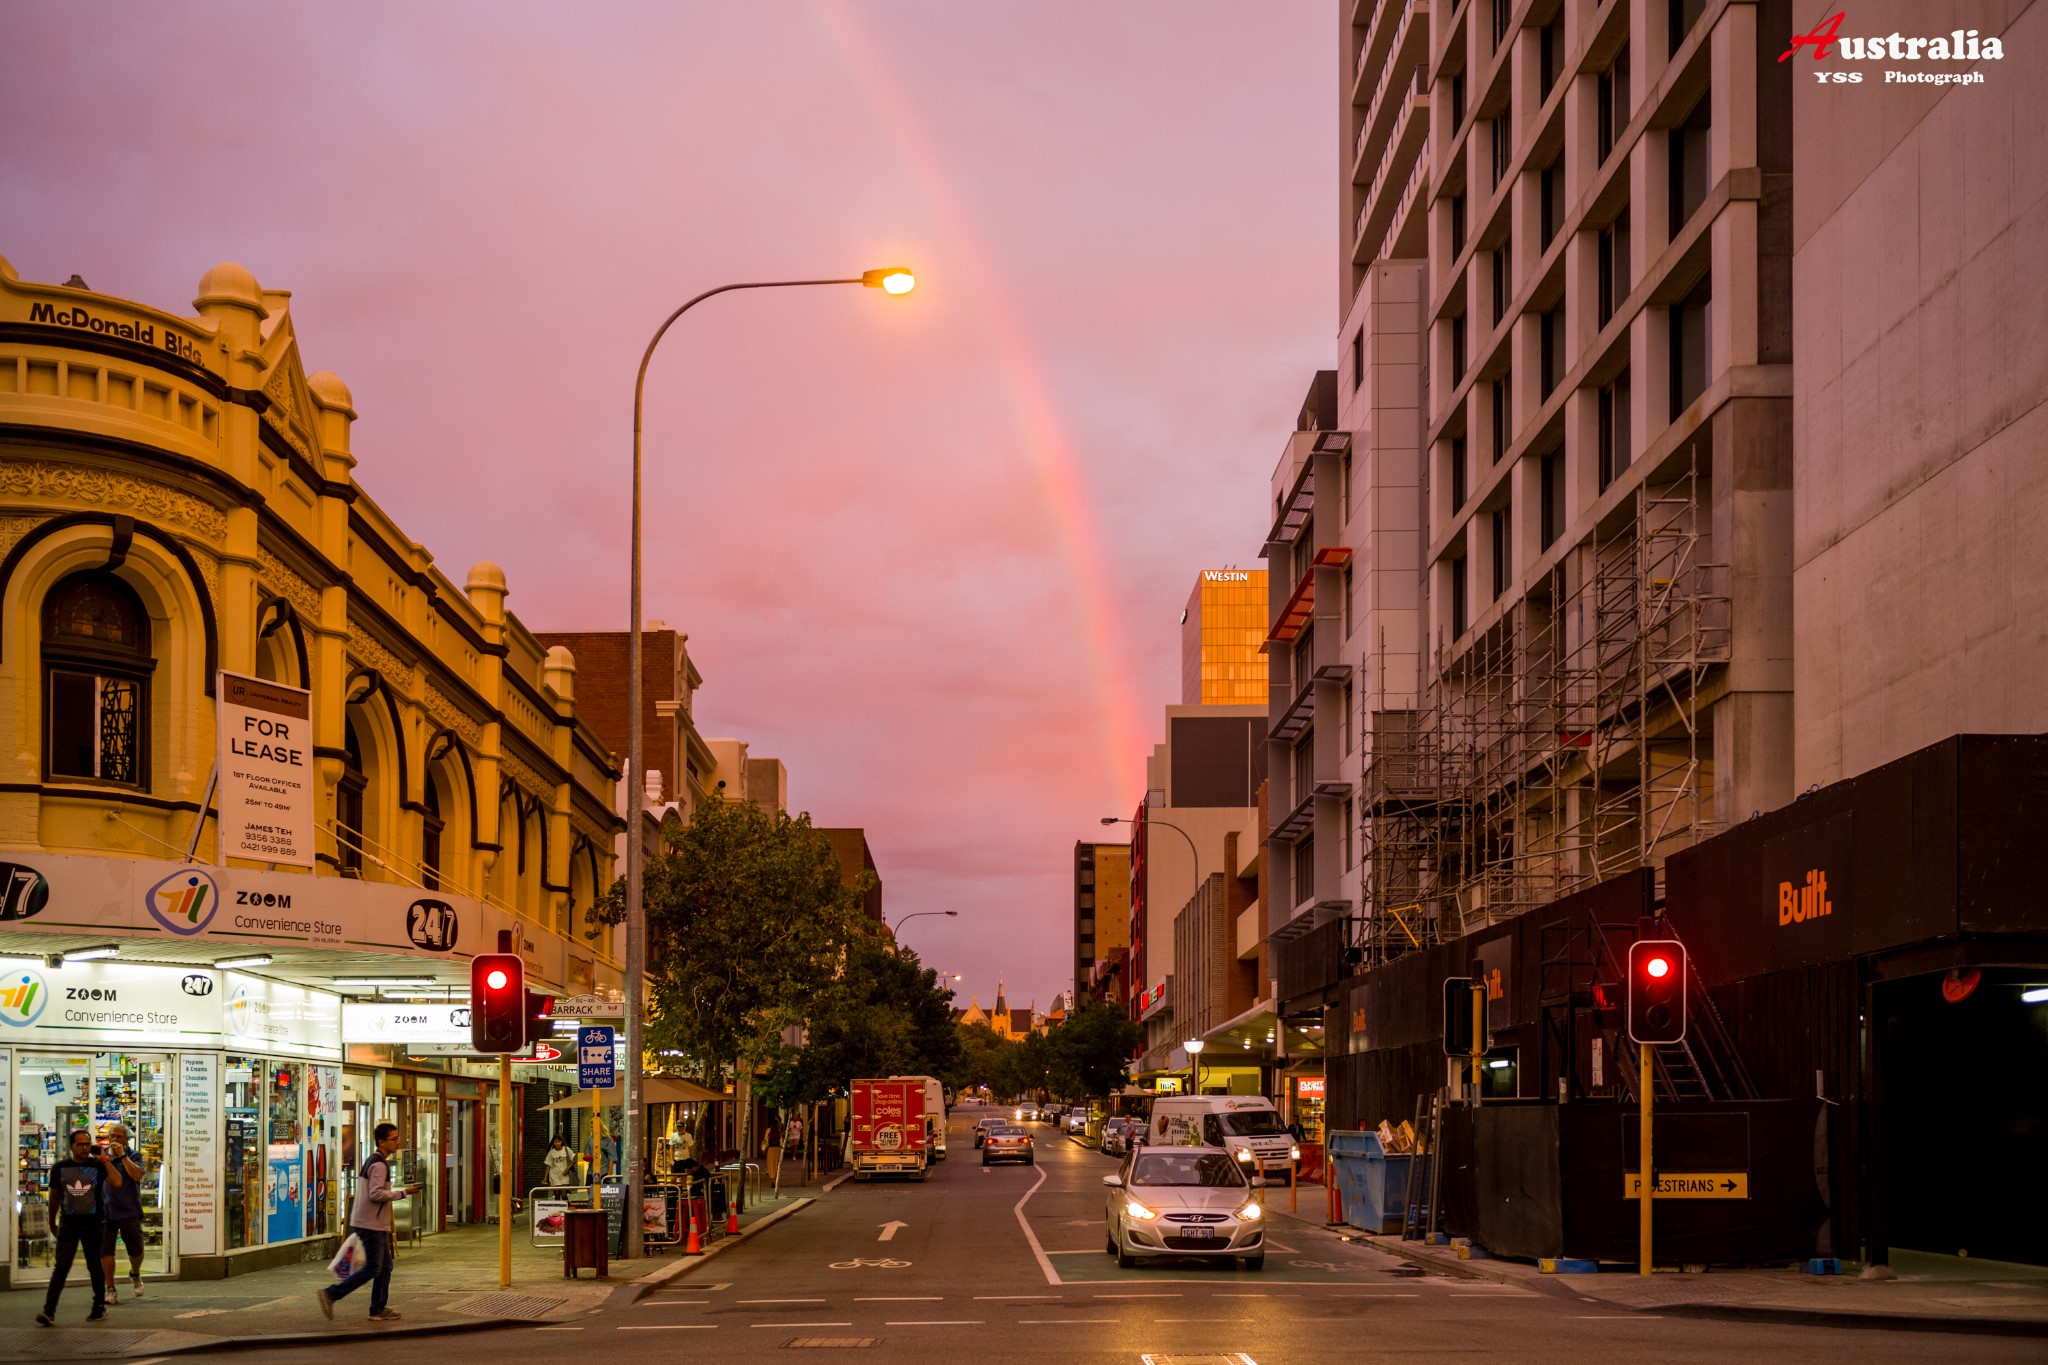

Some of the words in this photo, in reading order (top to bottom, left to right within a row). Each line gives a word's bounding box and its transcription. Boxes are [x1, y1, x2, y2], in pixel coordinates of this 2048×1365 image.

[29, 302, 154, 345] McDonald
[232, 685, 246, 697] UR
[244, 715, 290, 740] FOR
[231, 737, 303, 767] LEASE
[249, 782, 287, 795] AVAILABLE
[245, 822, 273, 834] JAMES
[275, 826, 292, 836] TEH
[245, 832, 268, 843] 9356
[269, 835, 292, 846] 3388
[240, 841, 260, 851] 0421
[261, 844, 279, 854] 999
[280, 846, 297, 856] 889
[236, 890, 292, 909] ZOOM
[1779, 868, 1832, 927] Built.
[234, 915, 311, 933] Convenience
[313, 920, 342, 935] Store
[66, 987, 117, 1002] ZOOM
[64, 1009, 144, 1024] Convenience
[147, 1011, 178, 1024] Store
[552, 1005, 593, 1015] BARRACK
[394, 1015, 428, 1024] ZOOM
[44, 1072, 62, 1085] OPEN
[582, 1067, 611, 1076] SHARE
[582, 1077, 593, 1085] THE
[875, 1106, 902, 1115] coles
[879, 1131, 899, 1139] FREE
[1634, 1179, 1714, 1193] PESTRIANS
